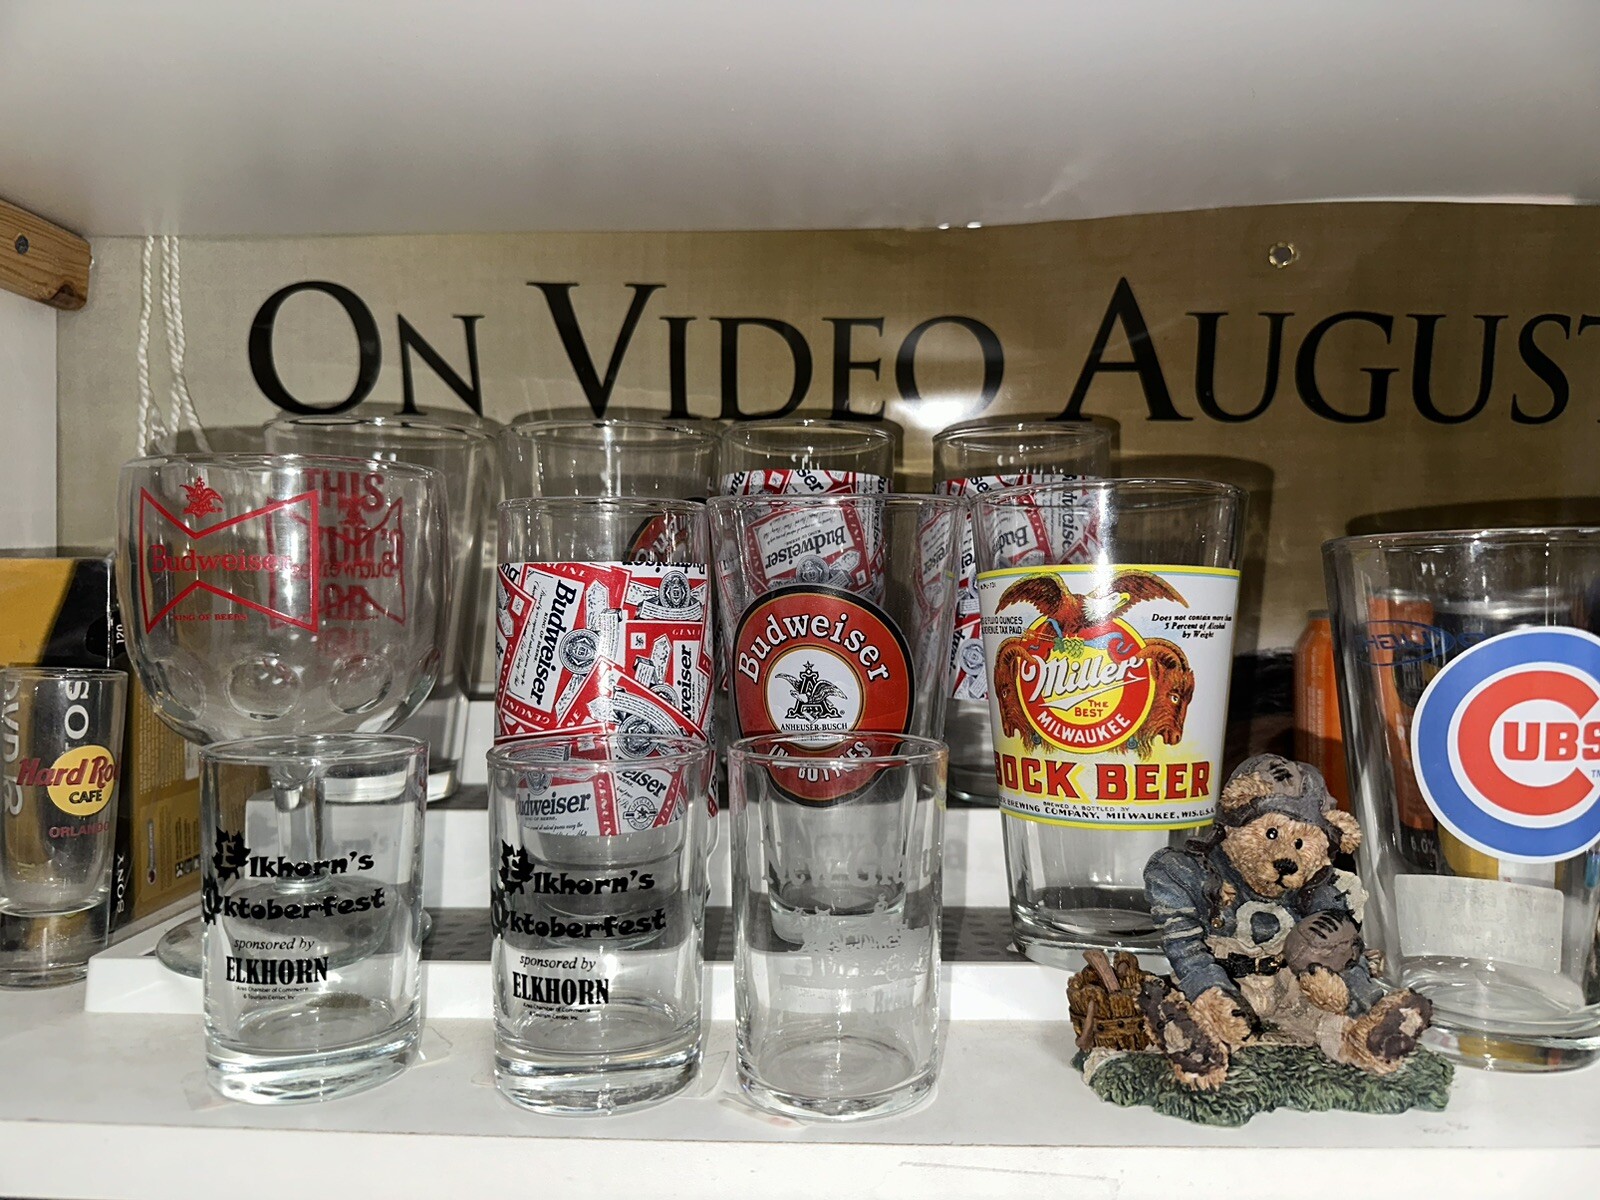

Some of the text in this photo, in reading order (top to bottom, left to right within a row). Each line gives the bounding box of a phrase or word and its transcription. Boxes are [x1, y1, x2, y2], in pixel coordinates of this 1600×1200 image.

[248, 280, 485, 418] ON
[526, 281, 1005, 422] VIDEO
[149, 544, 292, 573] Budweiser
[999, 615, 1024, 625] OUNCES
[1151, 613, 1172, 622] Does
[1171, 621, 1198, 630] Percent
[530, 579, 577, 706] Budweiser
[738, 612, 890, 684] Budweiser
[1182, 630, 1191, 639] by
[1020, 654, 1146, 703] Miller
[1074, 706, 1104, 718] BEST
[1088, 699, 1109, 708] THE
[1036, 711, 1132, 745] MILWAUKEE
[16, 757, 89, 787] Hard
[1096, 760, 1212, 801] BEER
[68, 789, 103, 805] CAFE
[1043, 800, 1070, 810] BREWED
[1081, 804, 1115, 812] BOTTLED
[49, 821, 110, 839] ORLANDO
[216, 840, 375, 879] Elkhorn's
[504, 852, 655, 896] Elkhorn's
[116, 852, 125, 913] SONY
[203, 886, 386, 921] Oktoberfest
[492, 900, 667, 939] Oktoberfest
[234, 936, 315, 952] sponsored by
[226, 956, 329, 985] ELKHORN
[519, 954, 597, 971] sponsored by
[512, 971, 610, 1006] ELKHORN
